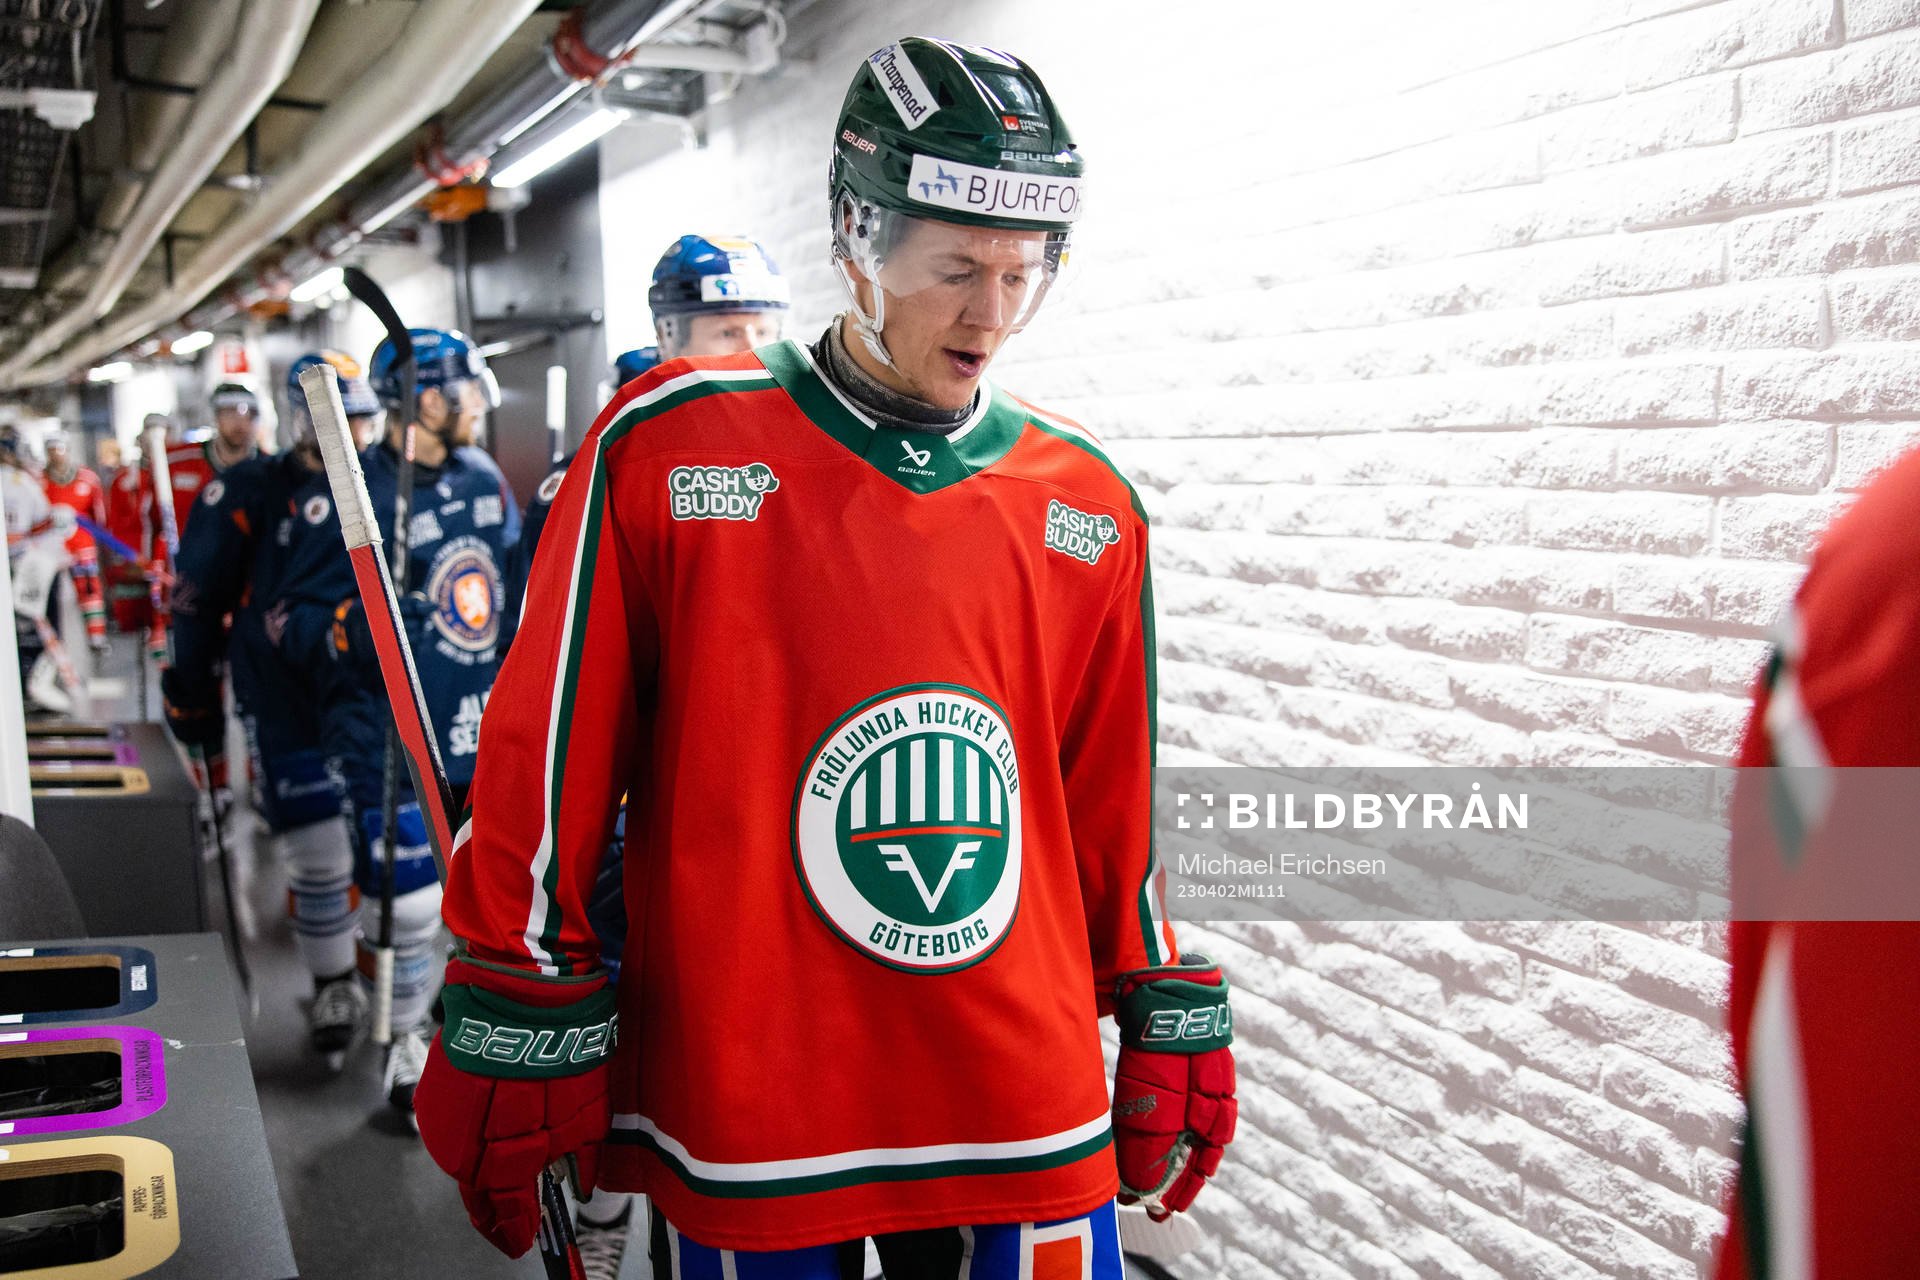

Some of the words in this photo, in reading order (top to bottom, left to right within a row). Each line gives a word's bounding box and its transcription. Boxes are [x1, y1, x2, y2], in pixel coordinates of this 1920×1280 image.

[880, 53, 927, 121] Tranpenad
[842, 129, 877, 155] BAUER
[1000, 150, 1064, 163] BAUE
[673, 471, 739, 493] CASH
[898, 466, 936, 477] BAUER
[675, 493, 758, 516] BUDDY
[1049, 504, 1094, 538] CASH
[1045, 523, 1102, 560] BUDDY
[811, 706, 908, 801] FRÖLUNDA
[918, 701, 998, 742] HOCKEY
[996, 738, 1018, 795] CLUB
[869, 917, 989, 957] GÖTEBORG
